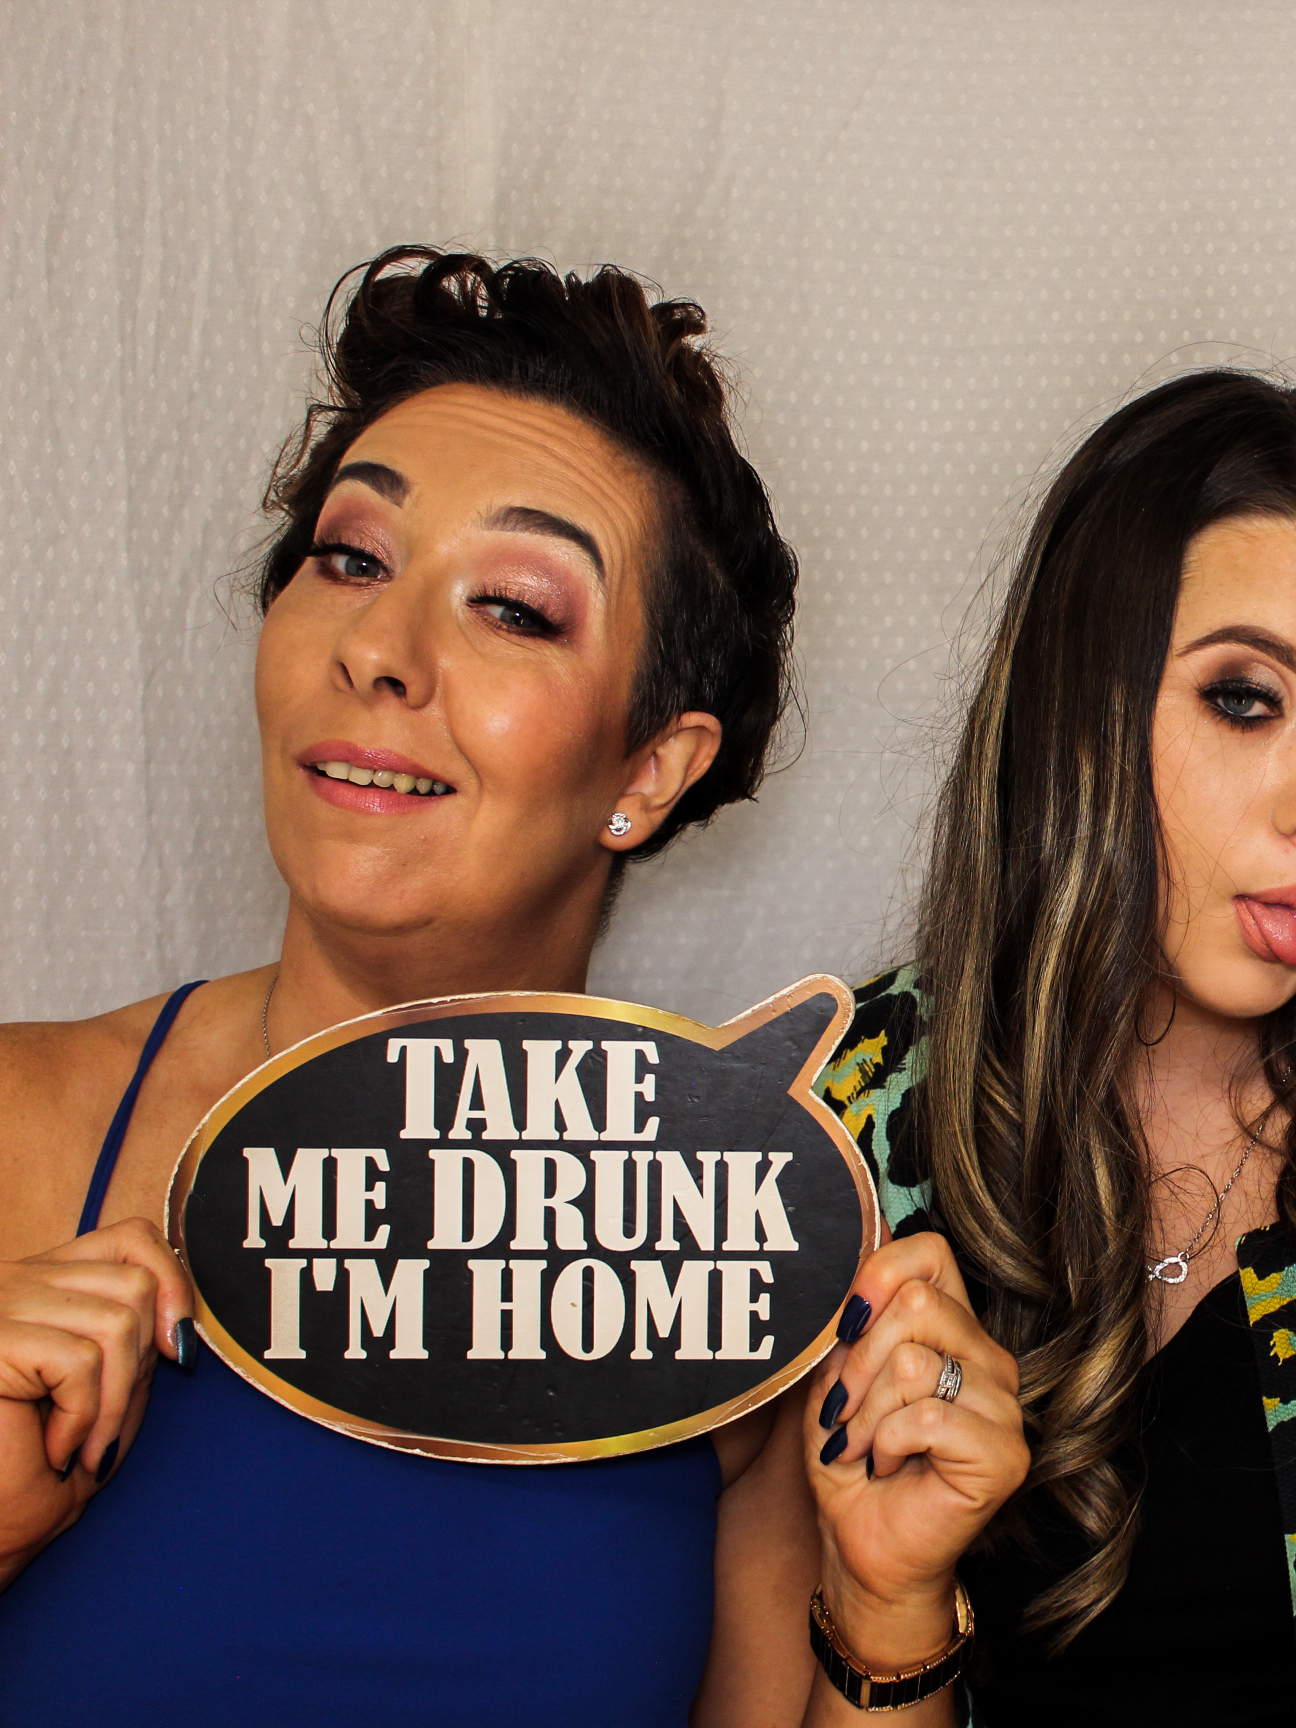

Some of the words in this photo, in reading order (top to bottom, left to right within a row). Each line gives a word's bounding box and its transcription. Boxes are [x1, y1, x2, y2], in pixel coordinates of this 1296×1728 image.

[386, 1038, 658, 1141] TAKE
[242, 1147, 391, 1250] ME
[427, 1148, 799, 1252] DRUNK
[262, 1258, 431, 1360] I'M
[466, 1259, 775, 1361] HOME
